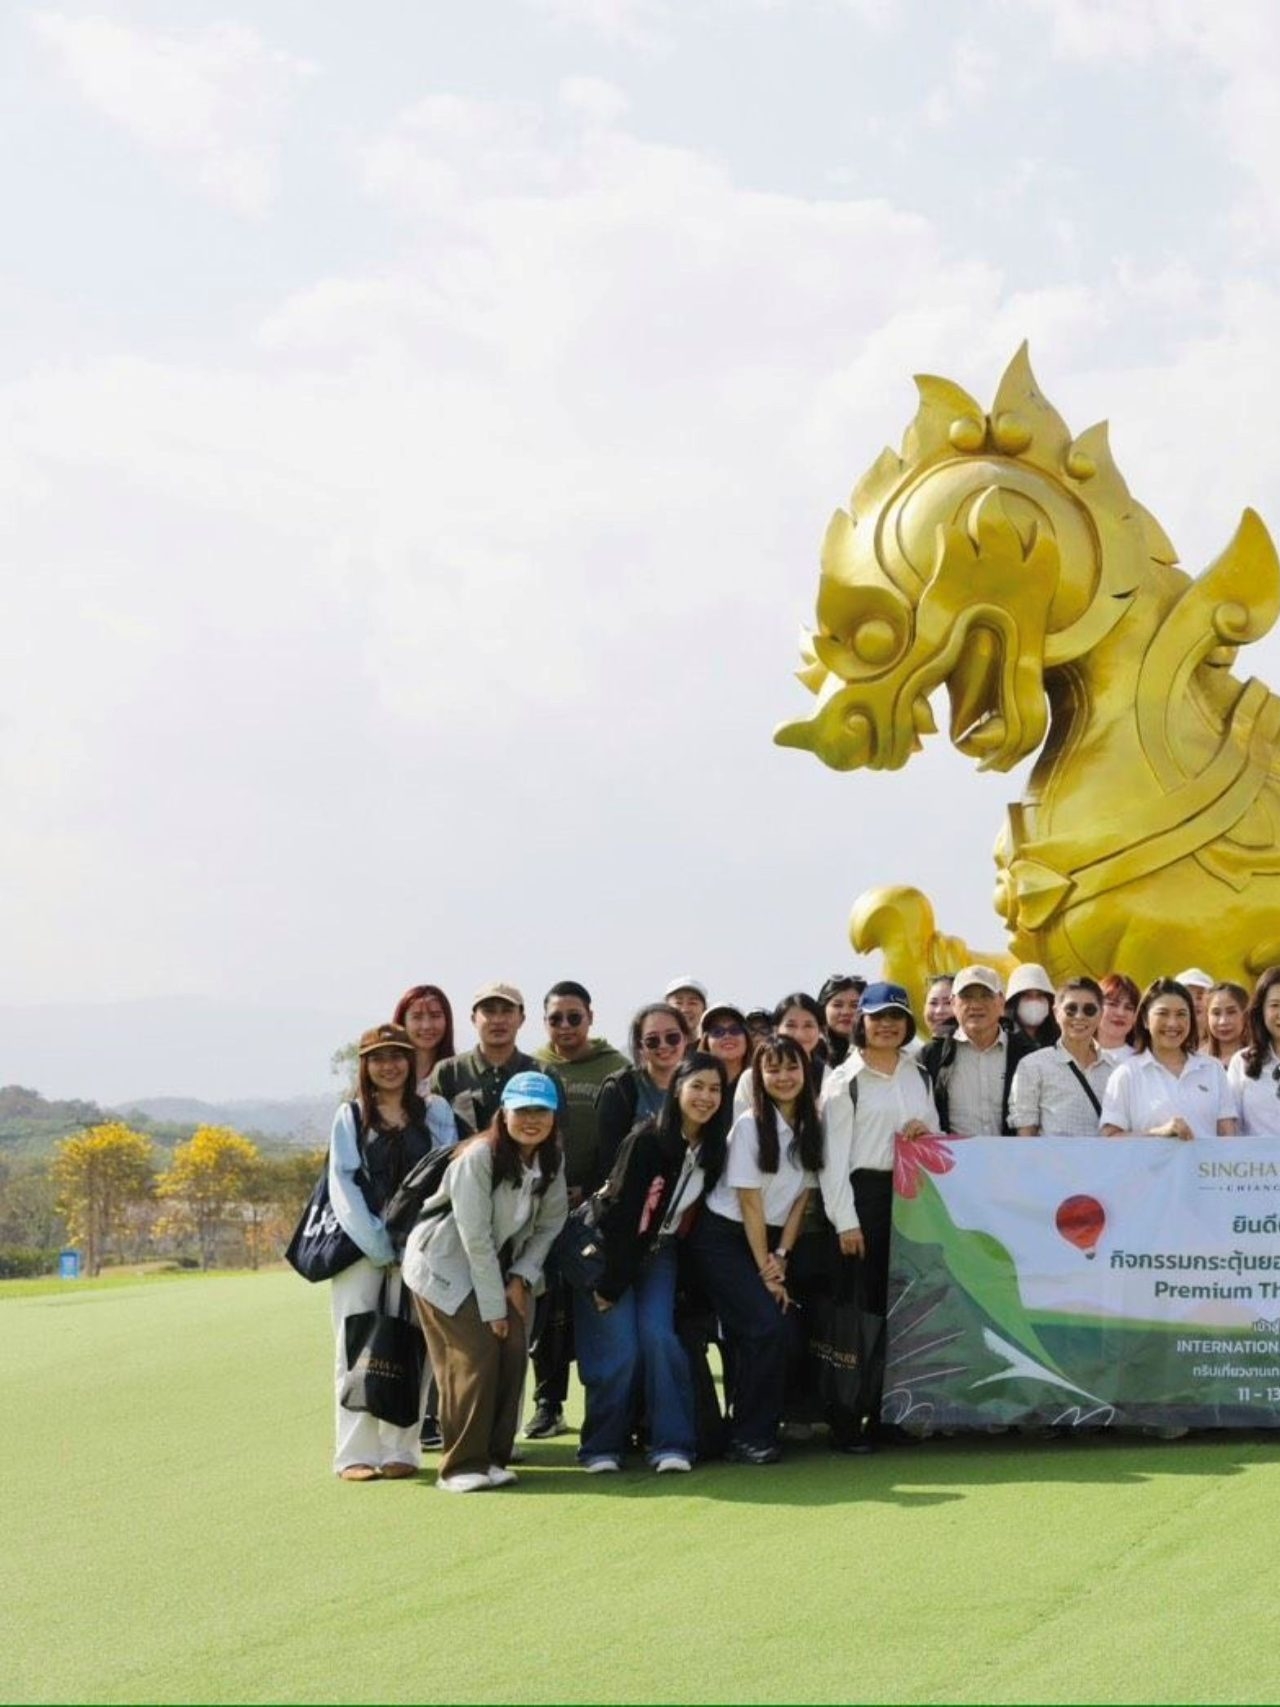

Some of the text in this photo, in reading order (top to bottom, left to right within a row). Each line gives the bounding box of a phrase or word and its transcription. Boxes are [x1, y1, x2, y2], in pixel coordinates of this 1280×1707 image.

[1198, 1161, 1277, 1178] SINGHA
[1154, 1281, 1253, 1300] Premium
[1237, 1387, 1250, 1401] 11
[1266, 1387, 1280, 1401] 13
